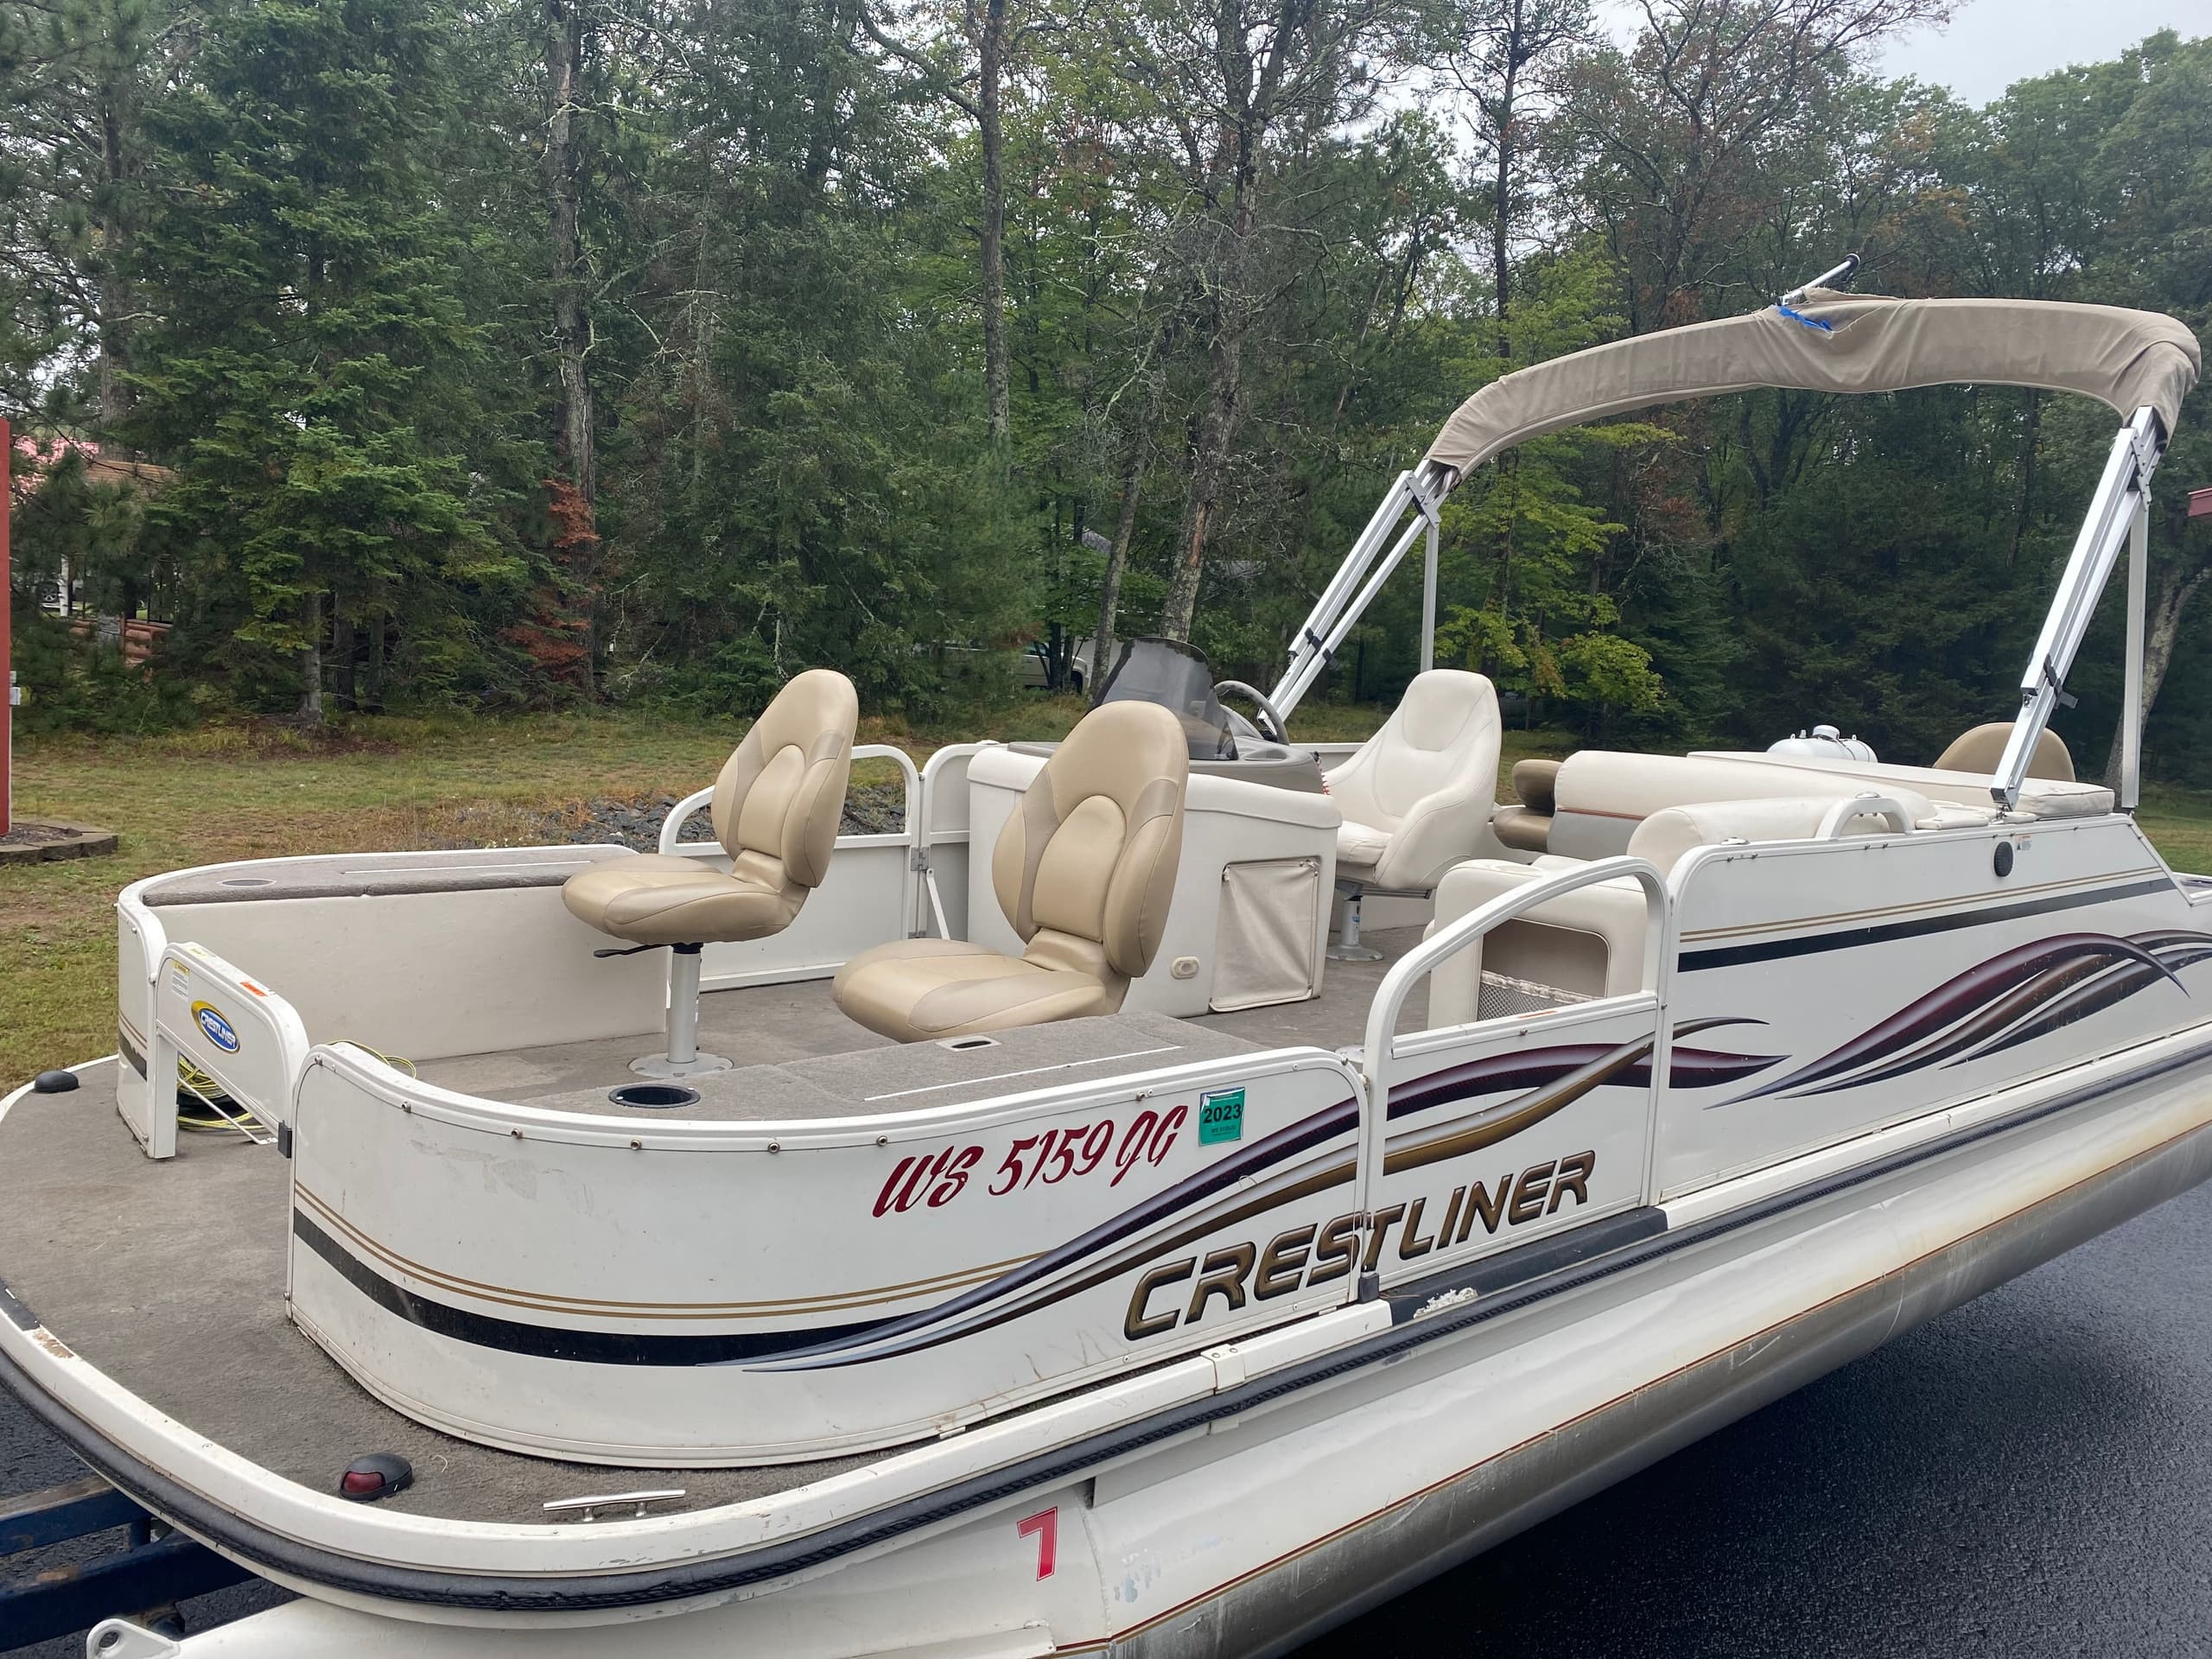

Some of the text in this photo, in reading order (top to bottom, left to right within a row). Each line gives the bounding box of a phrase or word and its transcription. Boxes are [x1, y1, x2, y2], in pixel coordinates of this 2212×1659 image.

[1202, 1103, 1242, 1124] 2023
[872, 1145, 984, 1218] WS
[988, 1119, 1115, 1197] 5159
[1123, 1149, 1596, 1341] CRESTLINER
